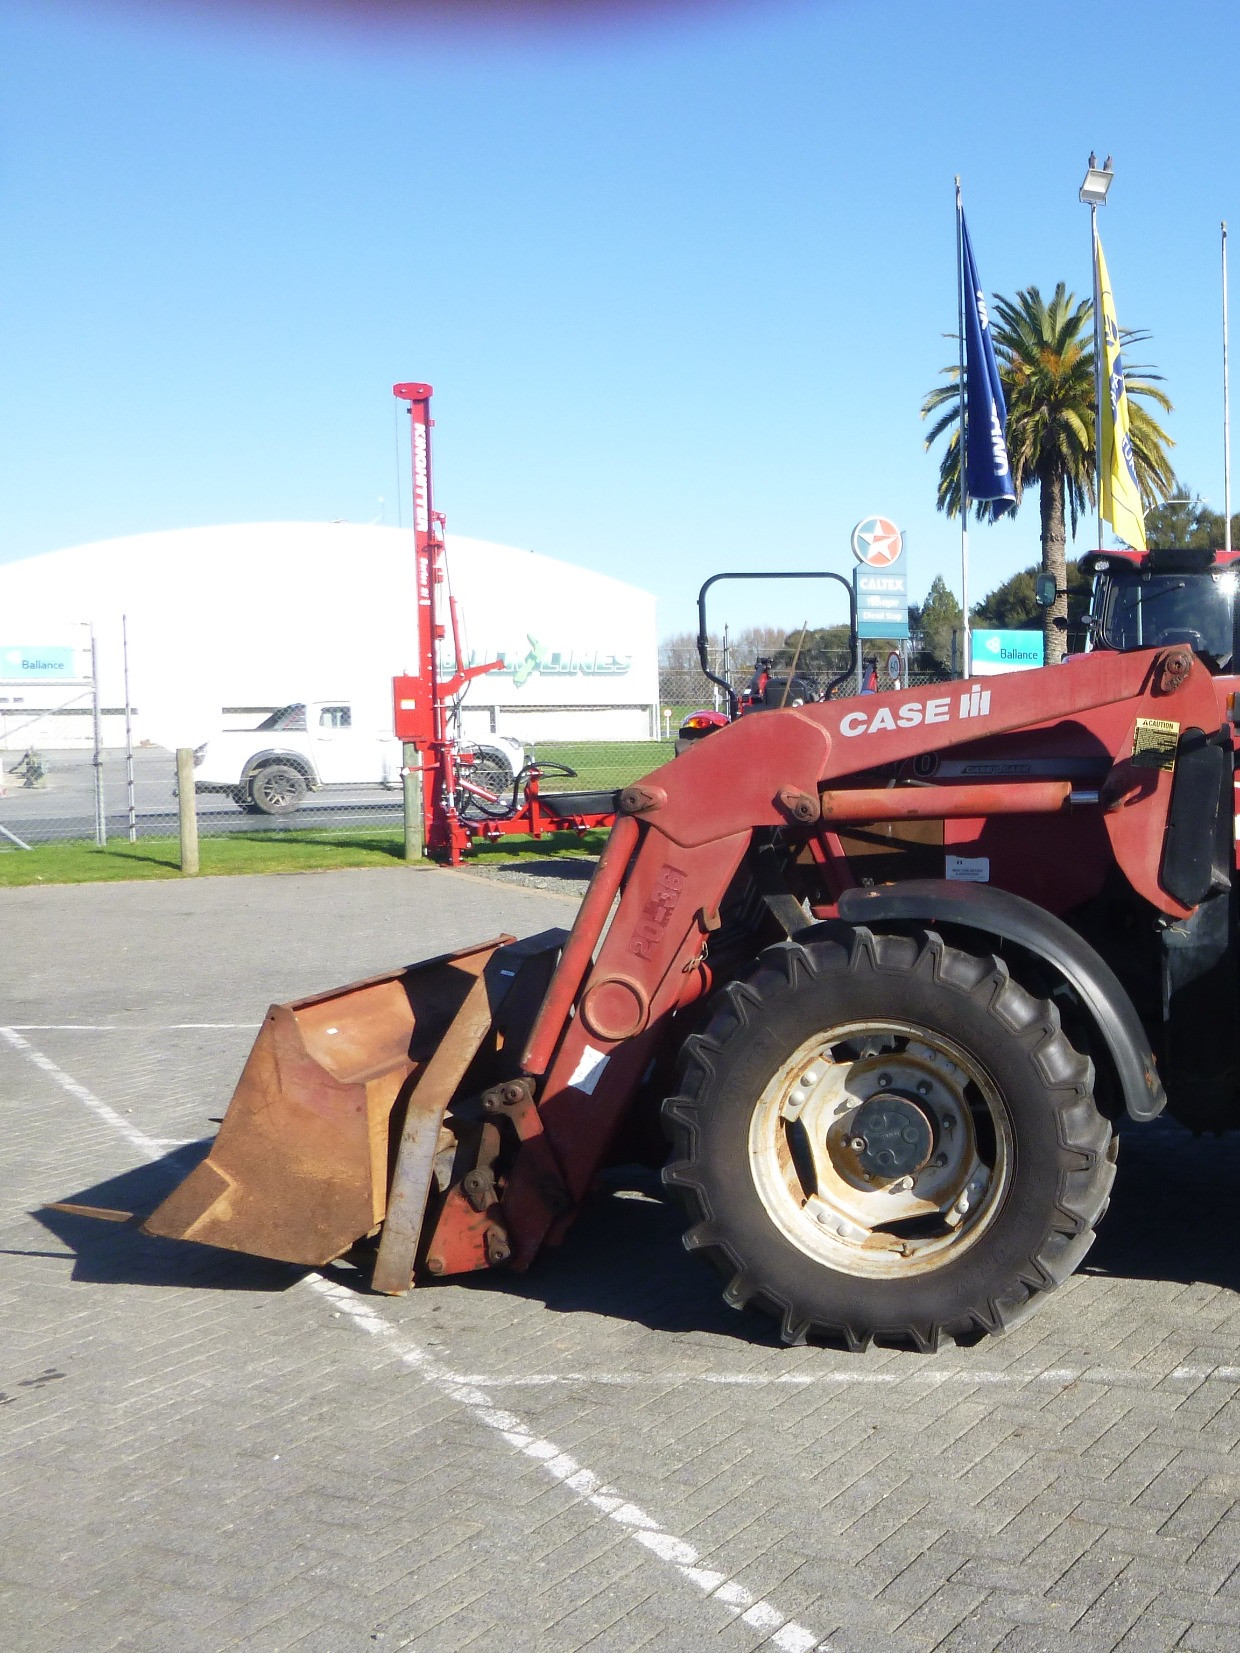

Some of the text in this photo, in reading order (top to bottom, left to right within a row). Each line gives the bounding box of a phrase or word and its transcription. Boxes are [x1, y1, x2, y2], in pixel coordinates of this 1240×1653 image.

[860, 577, 904, 591] CALTEX
[863, 611, 902, 622] Diesel Stop
[1000, 648, 1038, 660] Ballance
[21, 659, 65, 670] Ballance
[540, 650, 632, 677] LINES
[839, 697, 951, 738] CASE
[1148, 720, 1174, 730] CAUTION
